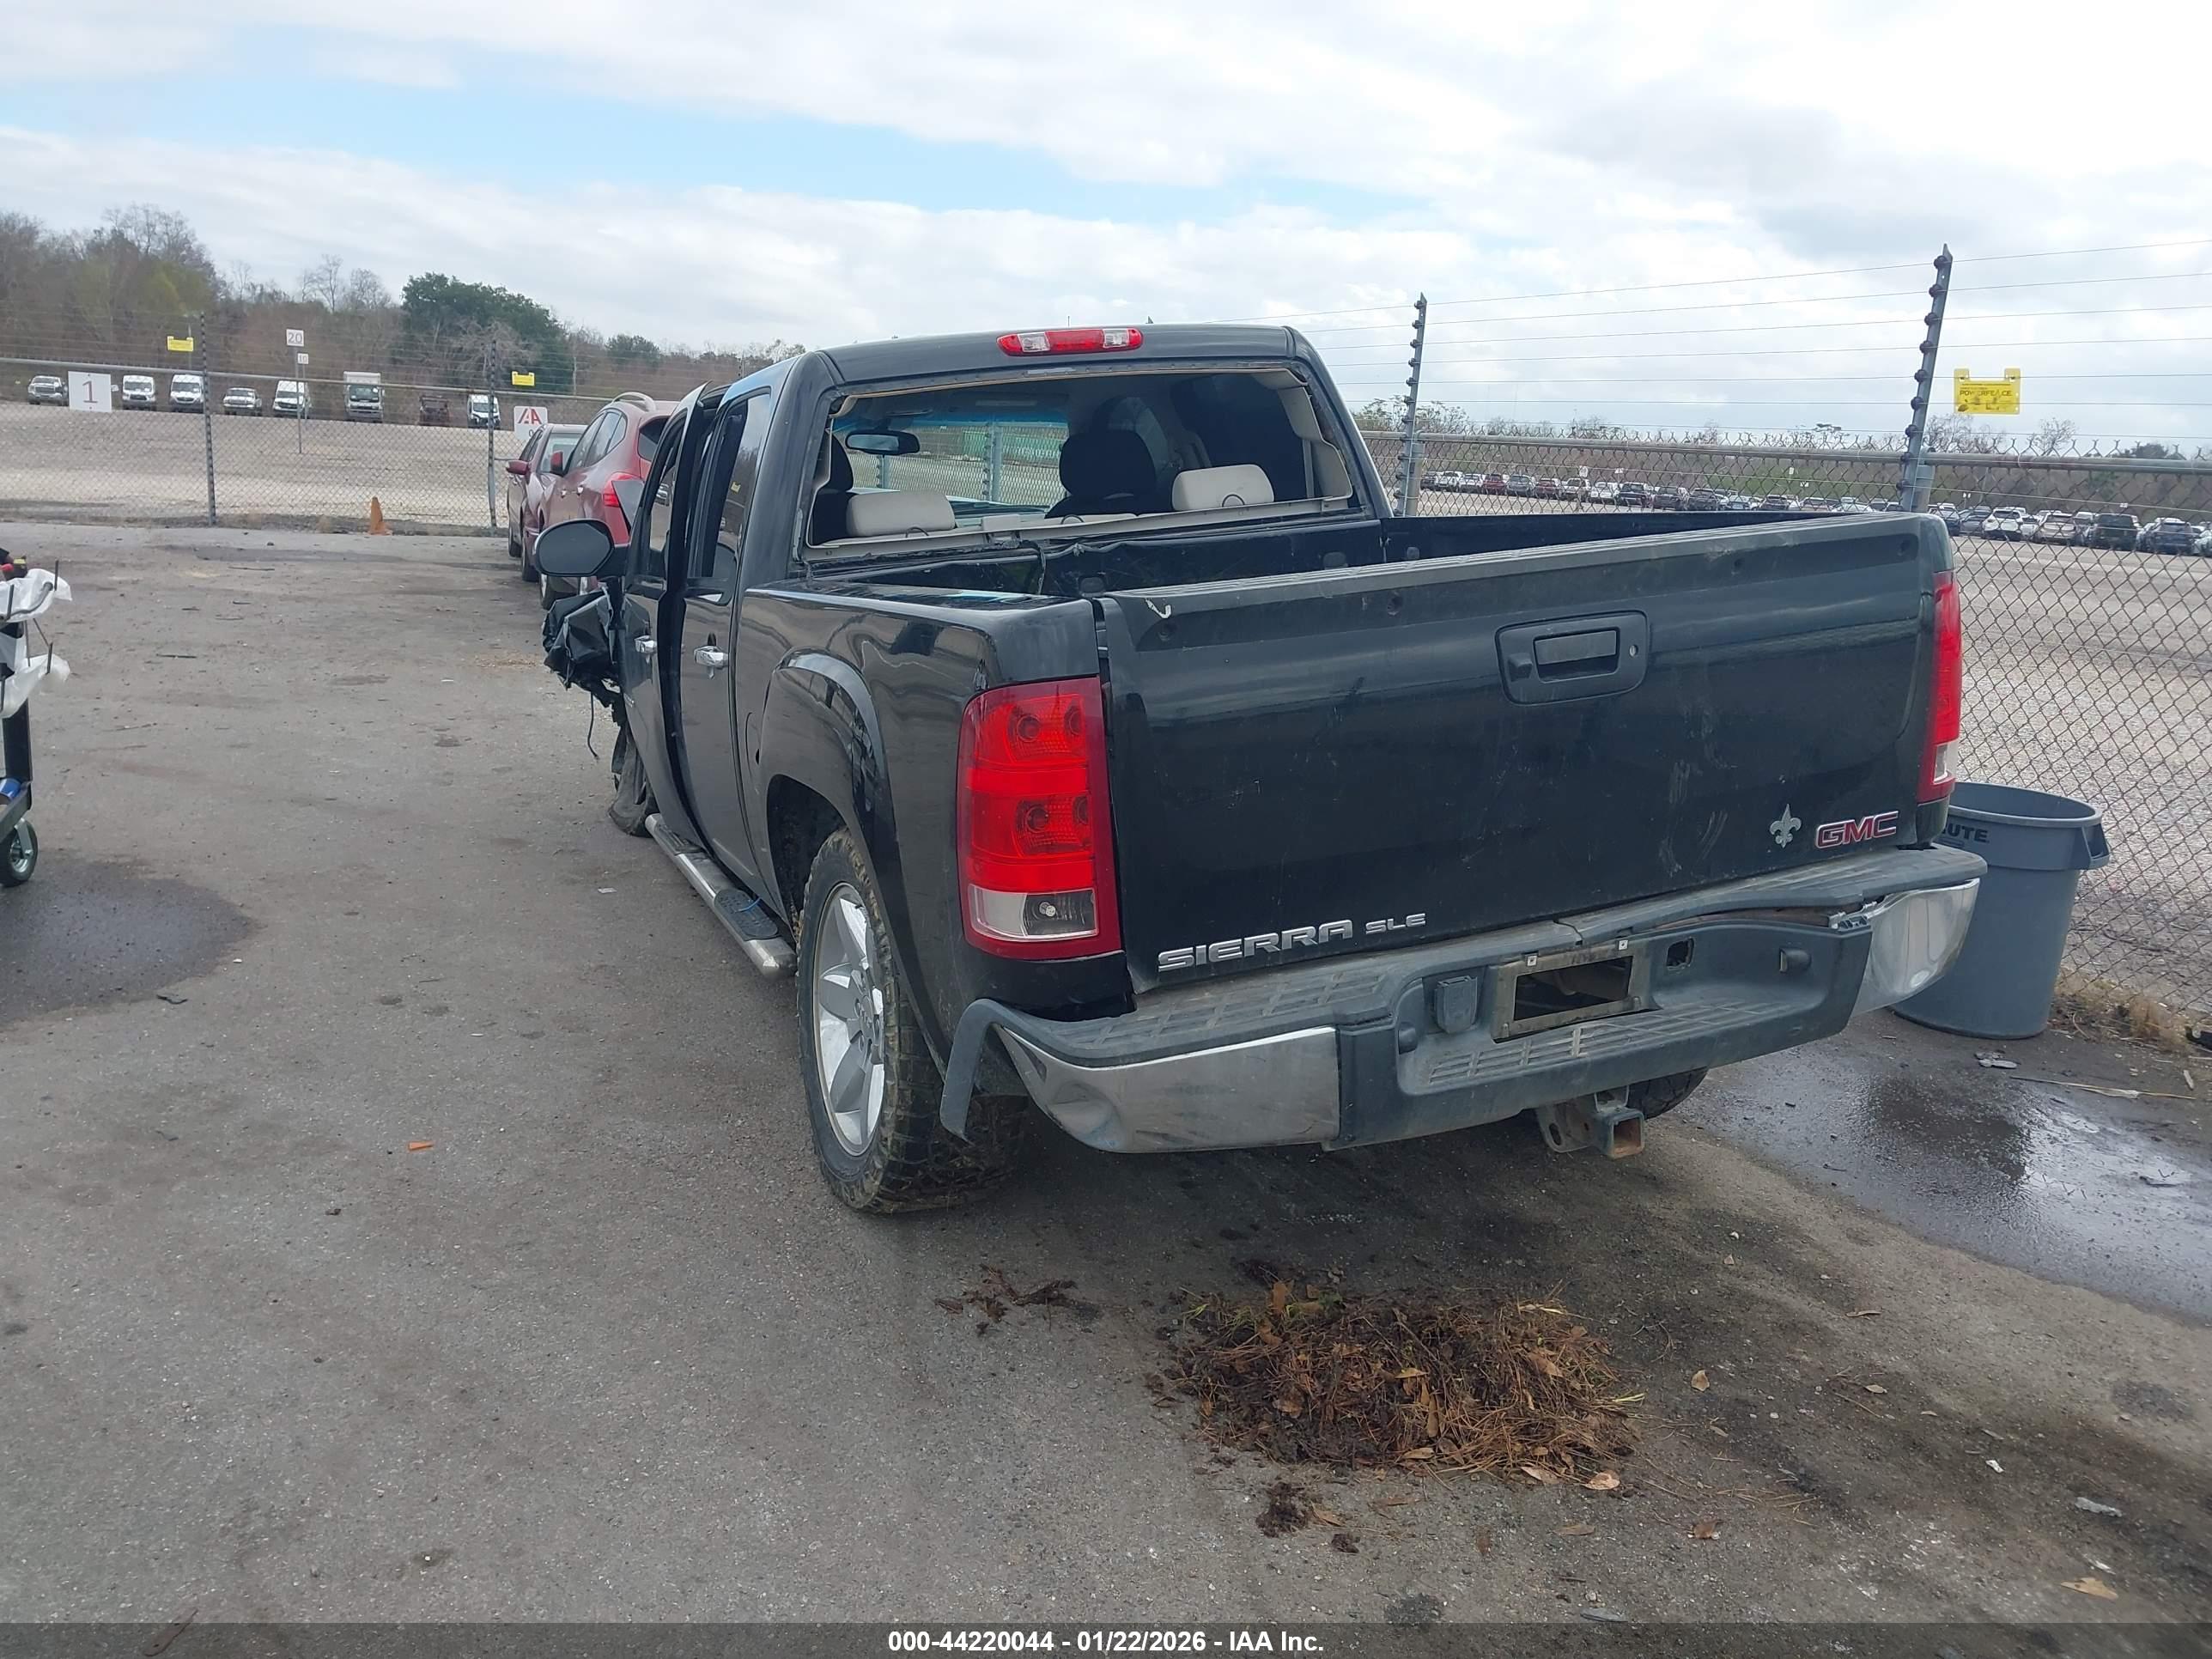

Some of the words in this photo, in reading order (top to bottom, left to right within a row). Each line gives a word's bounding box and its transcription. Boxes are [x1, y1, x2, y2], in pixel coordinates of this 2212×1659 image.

[288, 332, 303, 344] 20
[82, 380, 99, 404] 1
[1815, 811, 1899, 848] GMC
[1942, 823, 1988, 842] UTE
[1158, 919, 1353, 972] SIERRA
[1365, 913, 1426, 934] SLE
